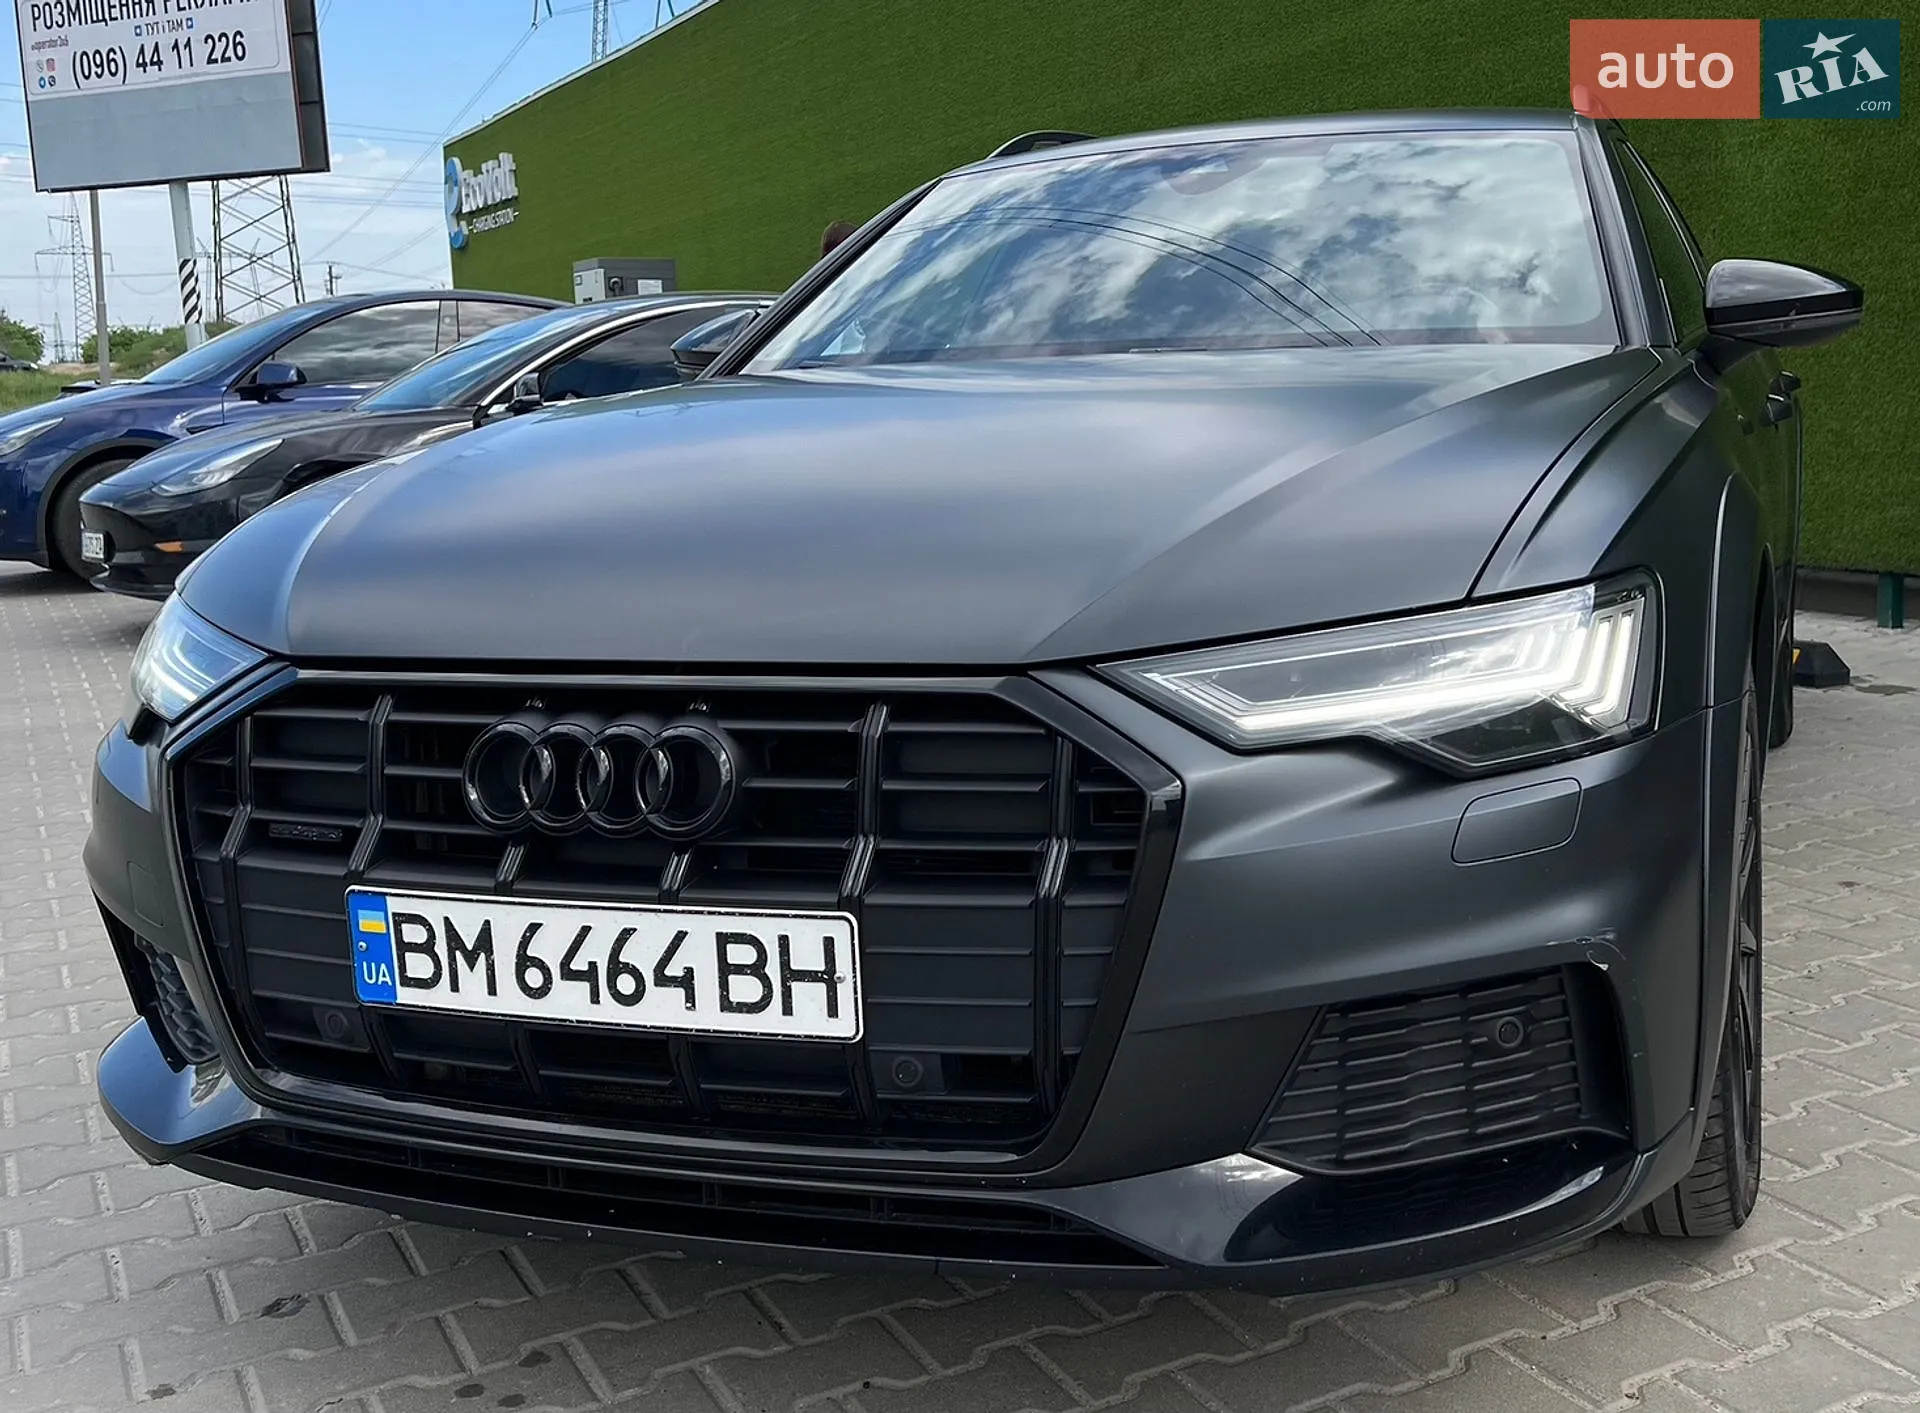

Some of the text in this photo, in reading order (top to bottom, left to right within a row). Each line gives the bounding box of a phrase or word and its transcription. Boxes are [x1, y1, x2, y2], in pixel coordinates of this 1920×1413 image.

[144, 21, 160, 36] ТУТ
[166, 18, 184, 32] ТАМ
[72, 30, 247, 89] (096) 44 11 226
[362, 961, 393, 986] UA
[392, 911, 839, 1019] BM 6464 BH
